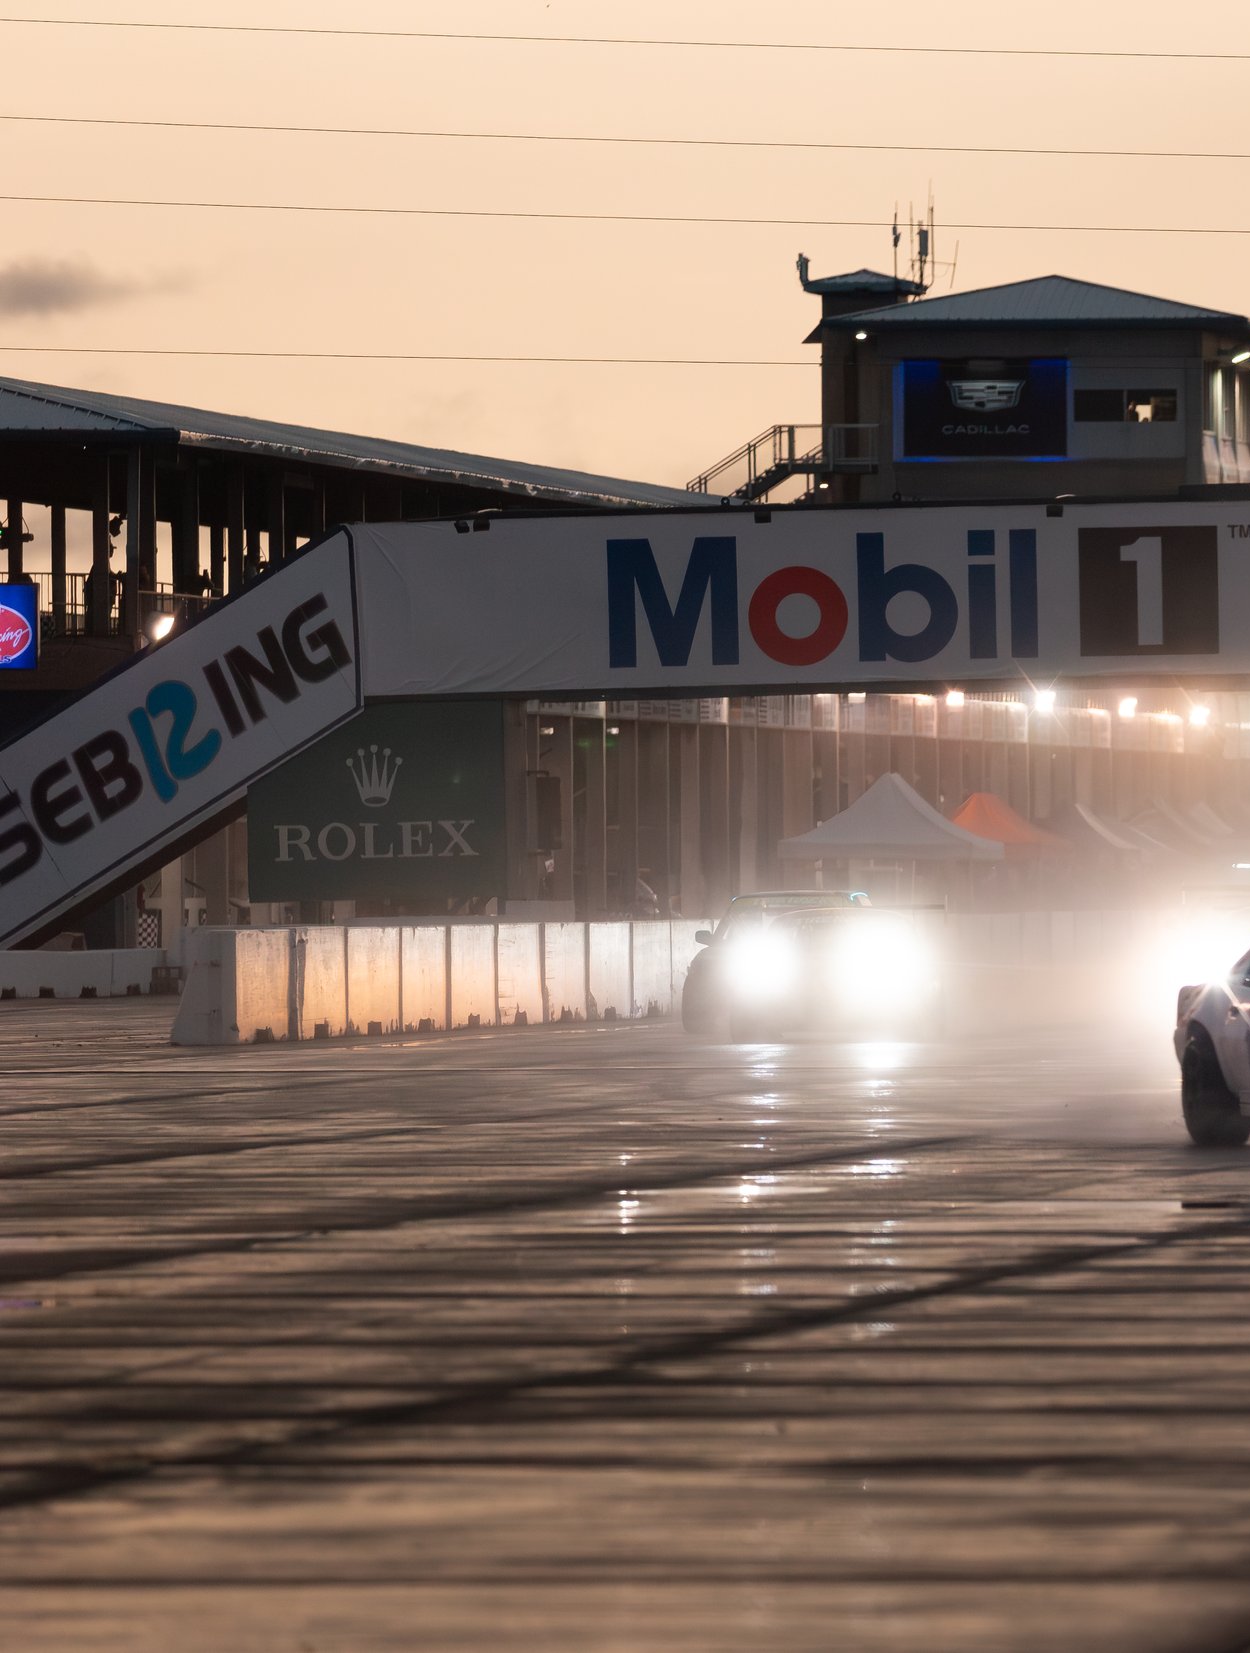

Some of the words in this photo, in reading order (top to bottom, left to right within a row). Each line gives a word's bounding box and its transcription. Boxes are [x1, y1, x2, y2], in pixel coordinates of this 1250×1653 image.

[941, 424, 1030, 435] CADILLAC
[607, 528, 1039, 668] Mobil
[273, 819, 479, 863] ROLEX
